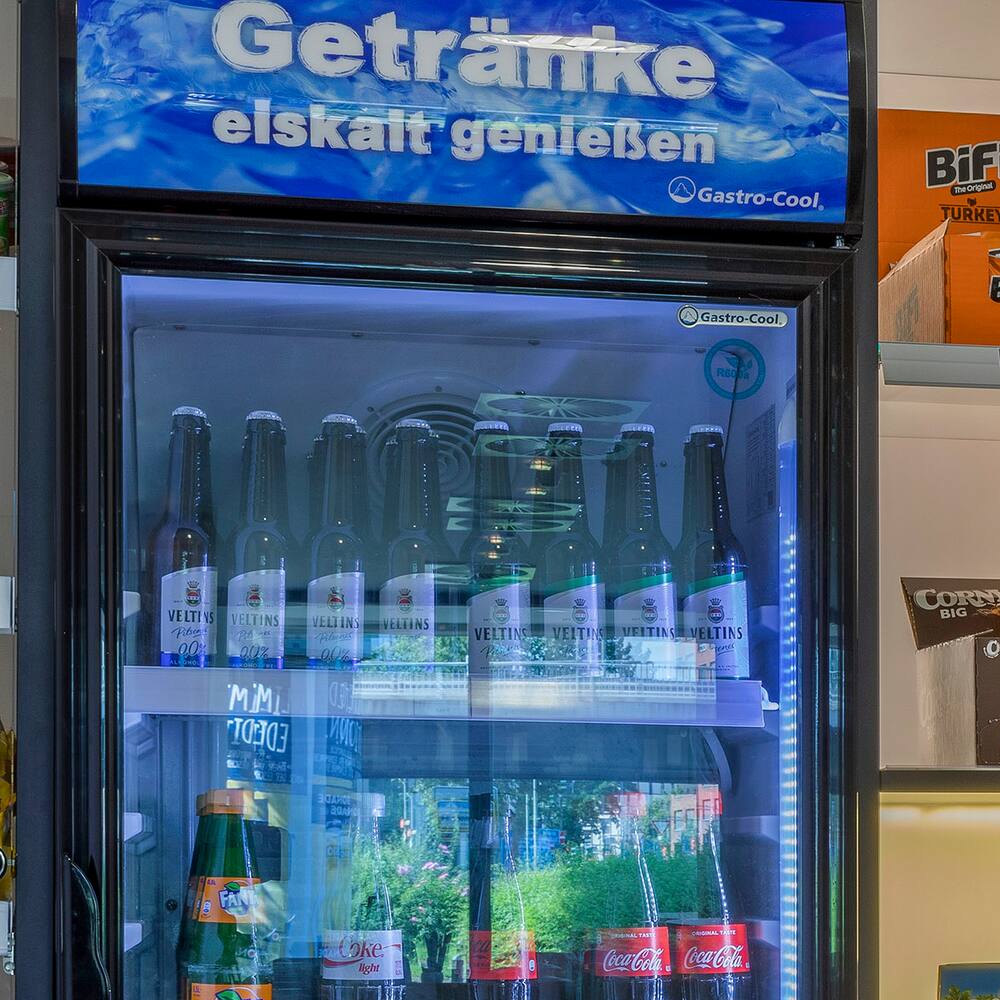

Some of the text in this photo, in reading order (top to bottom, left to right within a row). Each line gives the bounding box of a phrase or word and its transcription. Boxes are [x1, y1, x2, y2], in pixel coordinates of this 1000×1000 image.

[211, 0, 717, 99] Getränke
[211, 100, 716, 164] eiskalt genießen
[953, 182, 994, 194] The Original
[697, 187, 822, 209] Gastro-Cool
[700, 311, 779, 325] Gastro-Cool
[168, 609, 214, 624] VELTINS
[940, 608, 968, 620] BIG
[474, 627, 527, 642] VELTINS
[690, 626, 744, 641] VELTINS
[339, 935, 384, 959] Coke
[358, 961, 380, 976] light
